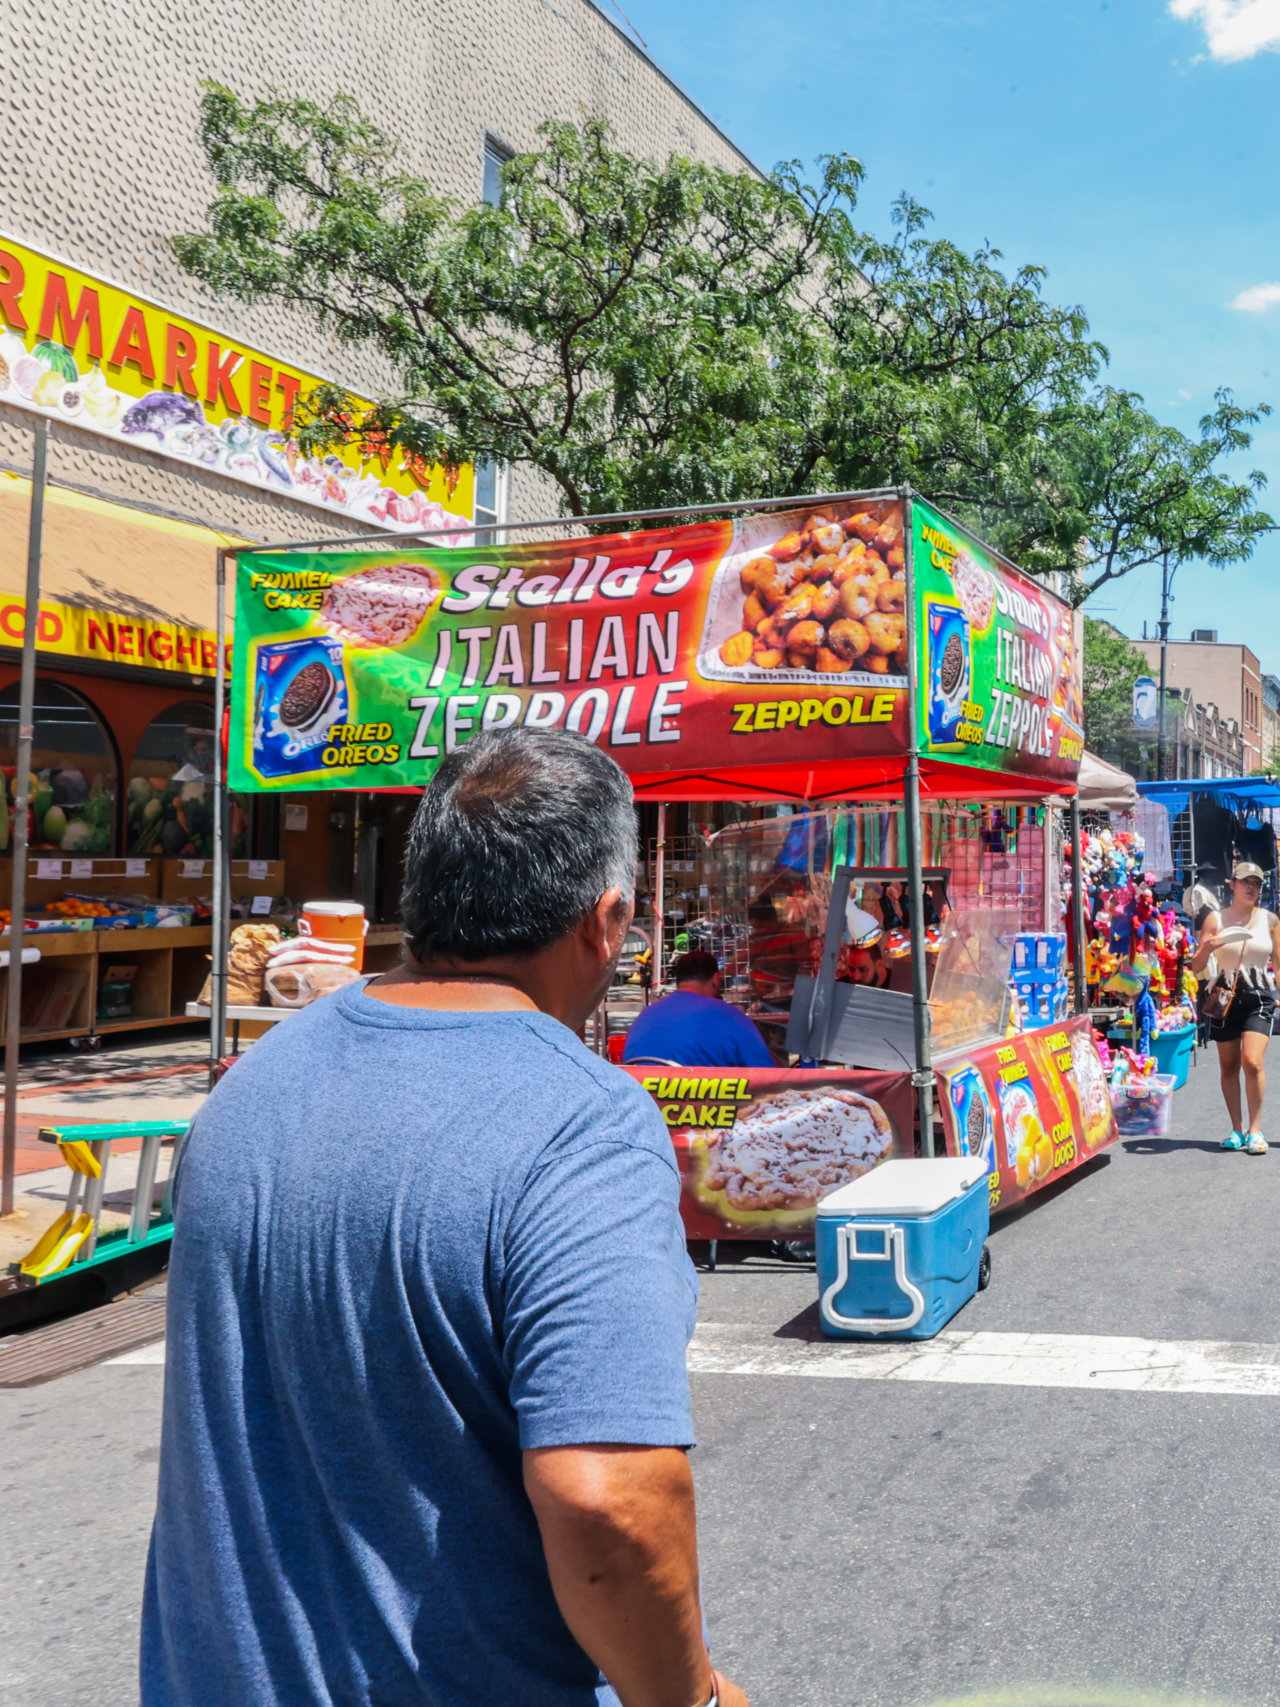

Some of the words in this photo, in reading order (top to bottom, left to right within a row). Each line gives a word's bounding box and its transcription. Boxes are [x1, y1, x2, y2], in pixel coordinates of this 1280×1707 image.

[250, 571, 332, 592] FUNNEL
[264, 591, 323, 611] CAKE
[428, 612, 680, 690] ITALIAN
[996, 626, 1053, 699] ITALIAN
[732, 694, 896, 734] ZEPPOLE
[960, 700, 985, 724] FRIED
[984, 688, 1054, 758] ZEPPOLE
[327, 722, 394, 744] FRIED
[955, 722, 984, 745] OREOS
[322, 744, 401, 767] OREOS
[642, 1077, 753, 1100] FUNNEL
[661, 1104, 736, 1127] CAKE
